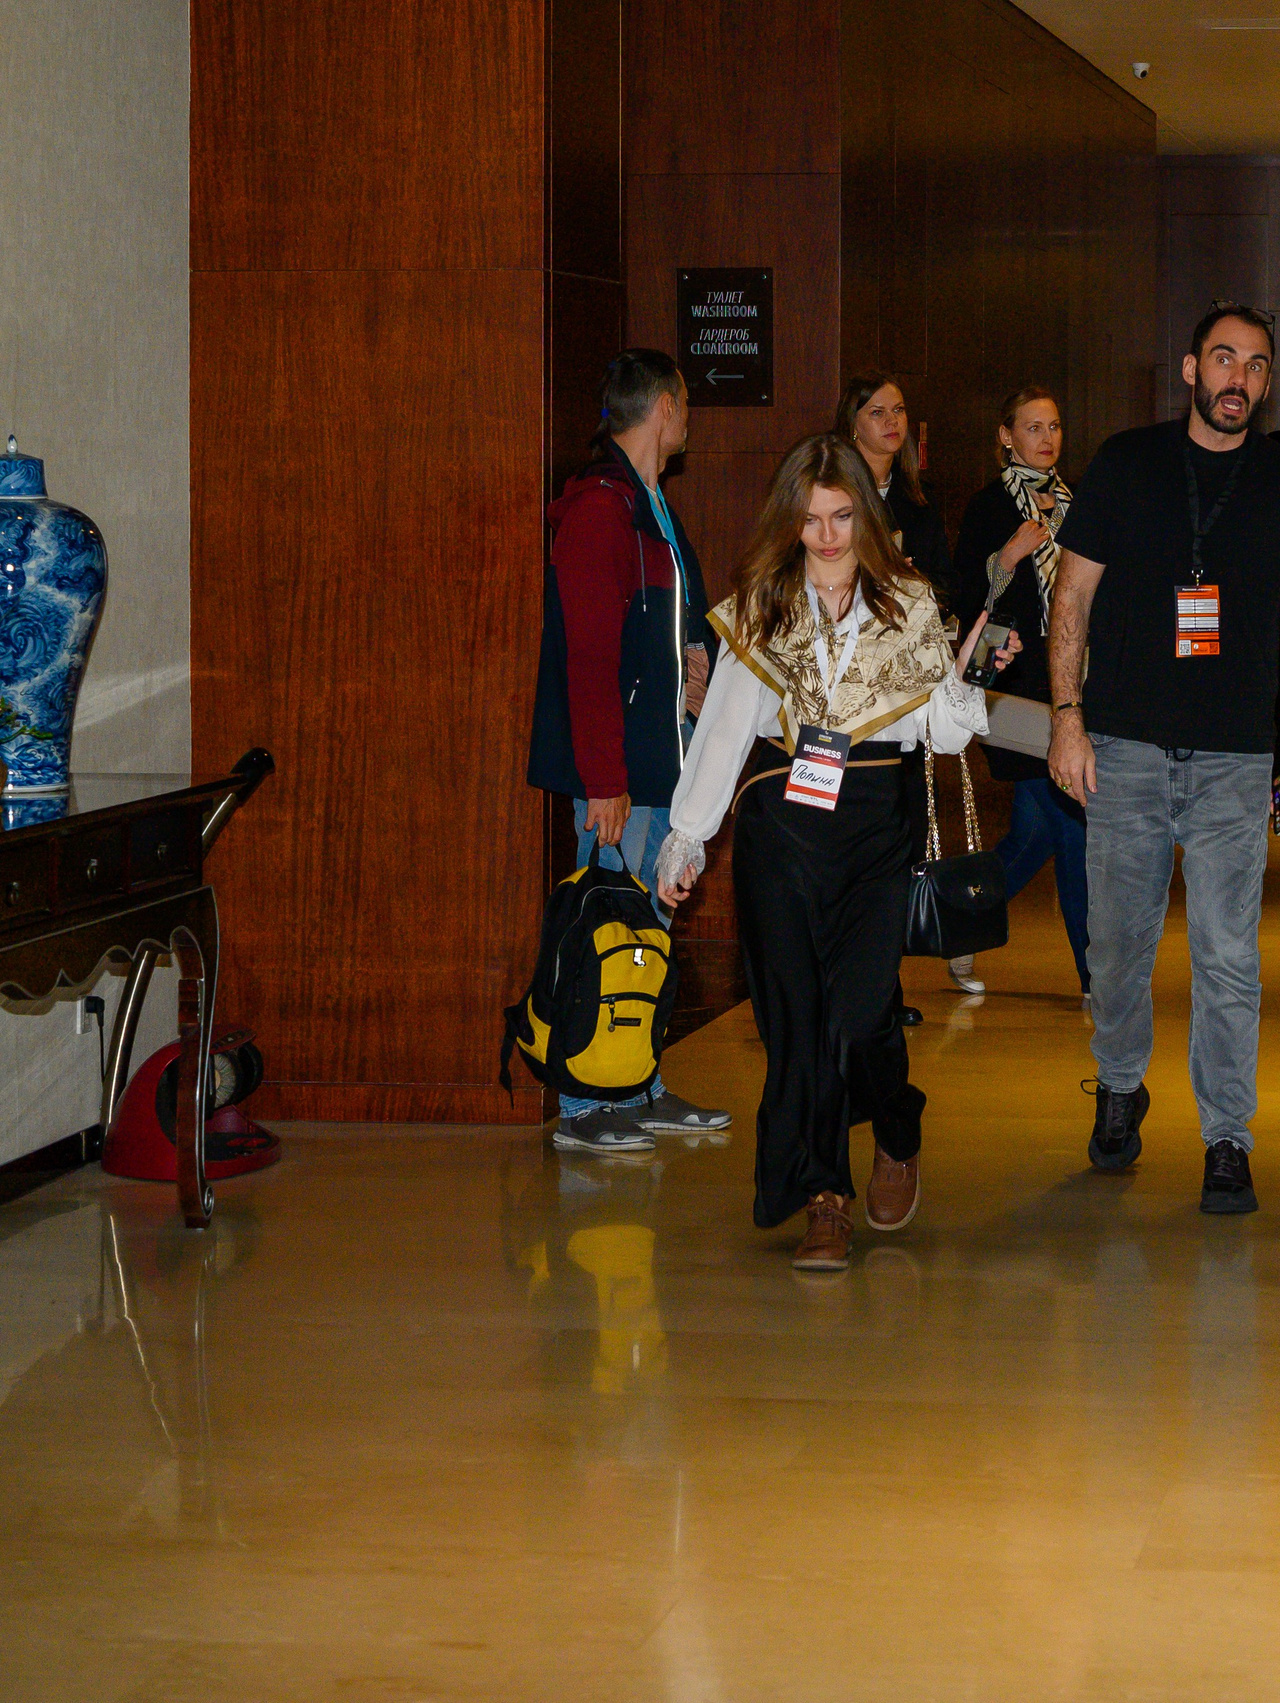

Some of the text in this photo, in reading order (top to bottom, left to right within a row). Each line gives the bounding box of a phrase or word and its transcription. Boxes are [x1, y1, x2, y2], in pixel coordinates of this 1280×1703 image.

[706, 291, 744, 303] ТУАЛЕТ
[691, 305, 758, 317] WASHROOM
[699, 329, 750, 342] ГАРДЕРОБ
[690, 342, 758, 355] CLOAKROOM
[803, 743, 842, 760] BUSINESS
